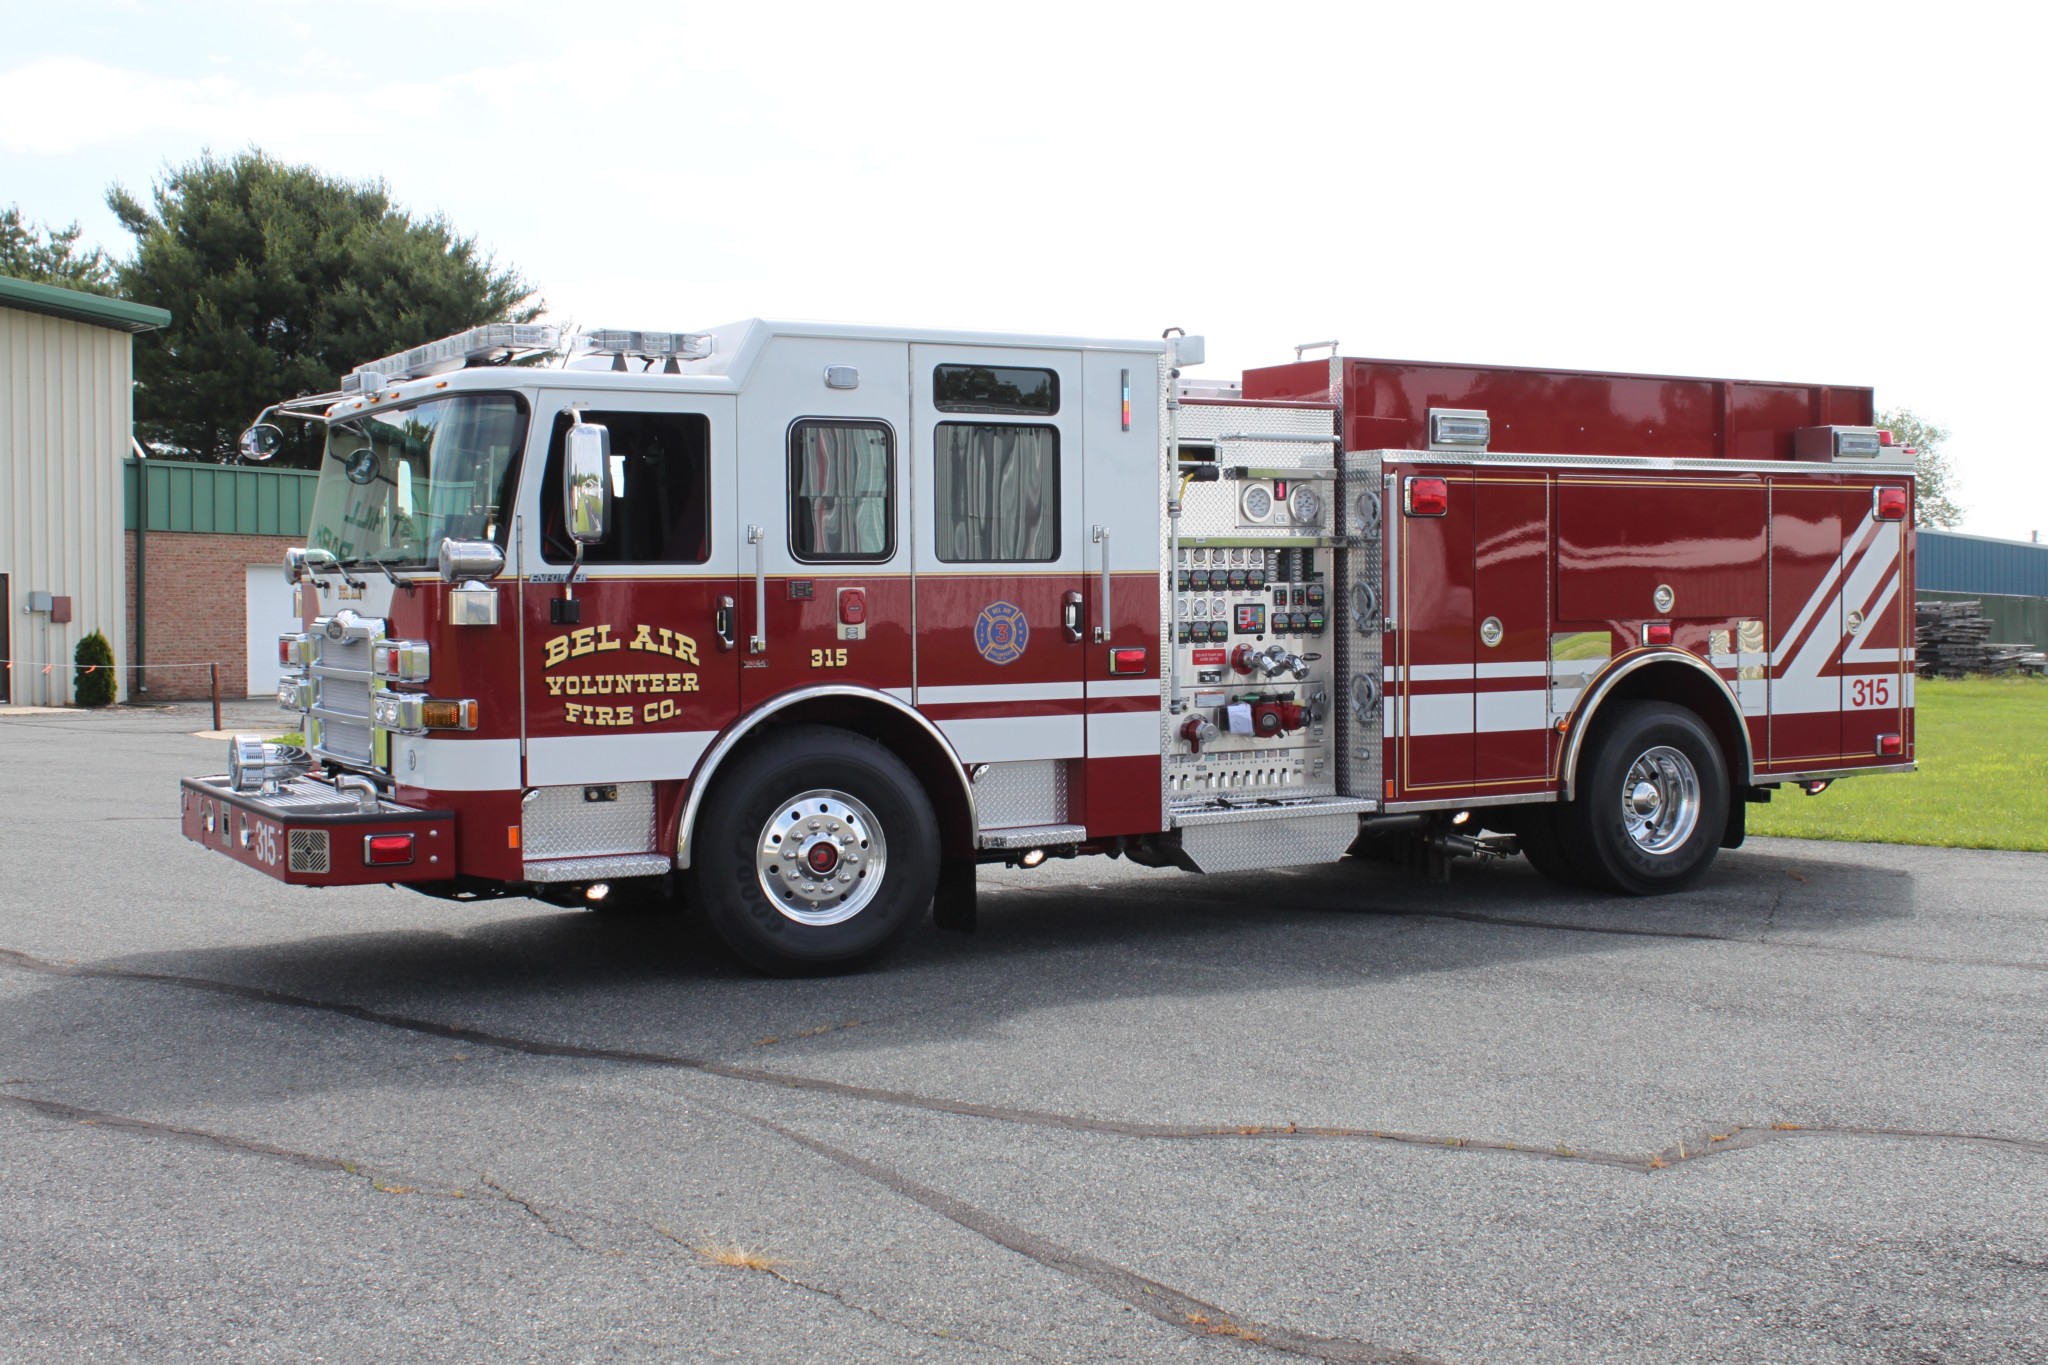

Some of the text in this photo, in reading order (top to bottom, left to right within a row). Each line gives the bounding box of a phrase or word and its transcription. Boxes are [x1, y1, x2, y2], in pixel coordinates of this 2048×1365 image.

[529, 574, 588, 583] ENFORER
[544, 623, 700, 669] BEL AIR
[995, 623, 1009, 643] 3
[811, 648, 848, 667] 315
[545, 672, 700, 696] VOLUNTEER
[1851, 678, 1889, 707] 315
[564, 698, 682, 726] FIRE CO.
[255, 820, 276, 867] 315
